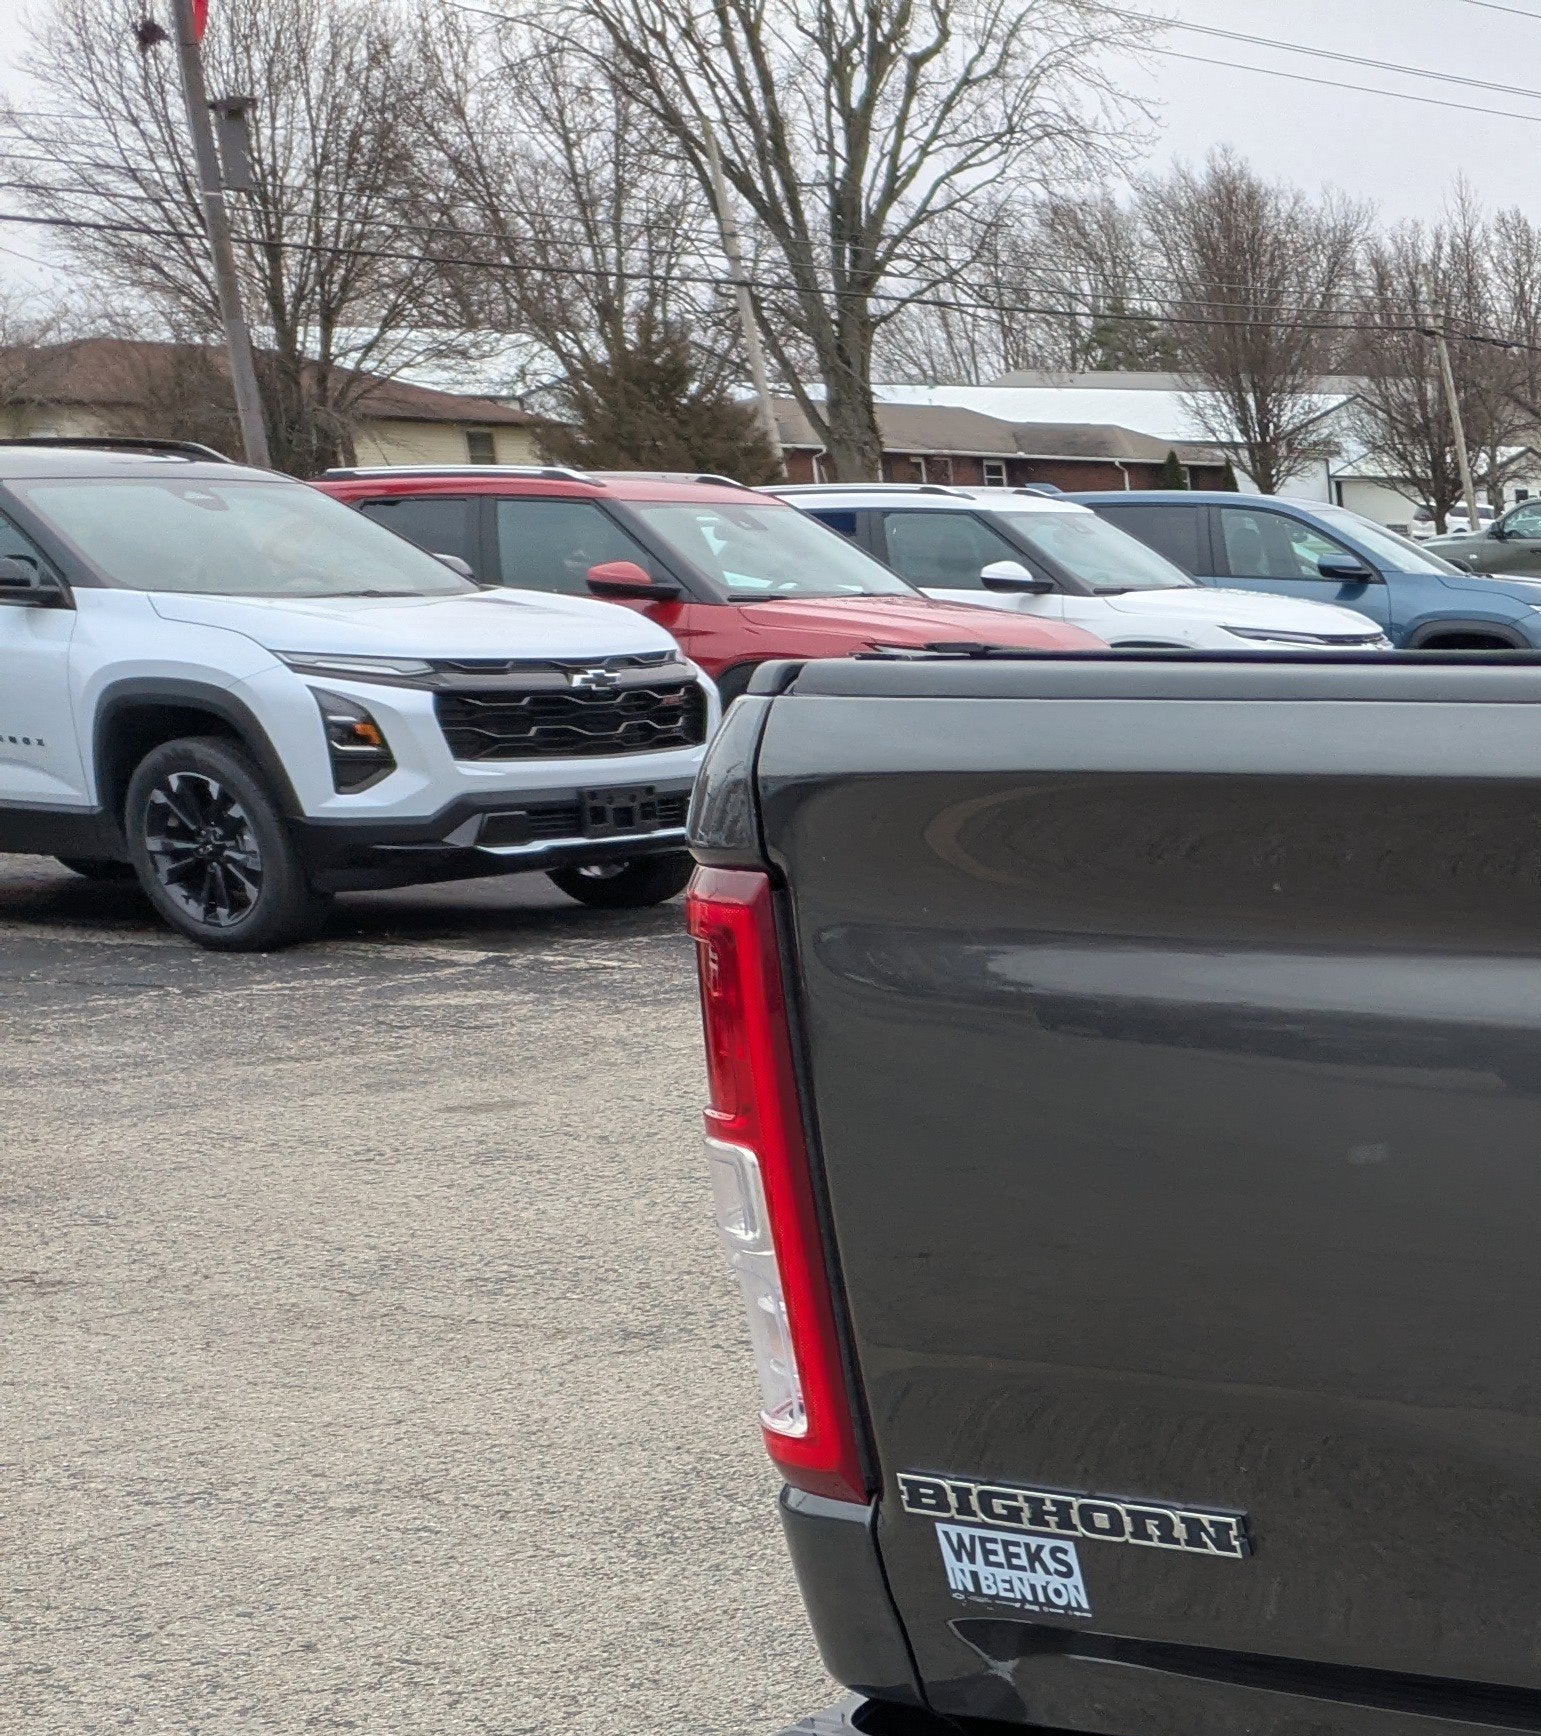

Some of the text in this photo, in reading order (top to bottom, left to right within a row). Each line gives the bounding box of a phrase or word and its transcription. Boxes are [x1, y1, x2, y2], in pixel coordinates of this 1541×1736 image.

[897, 1472, 1246, 1558] BIGHORN
[941, 1530, 1075, 1579] WEEKS
[948, 1567, 974, 1592] IN
[979, 1569, 1090, 1609] BENTON
